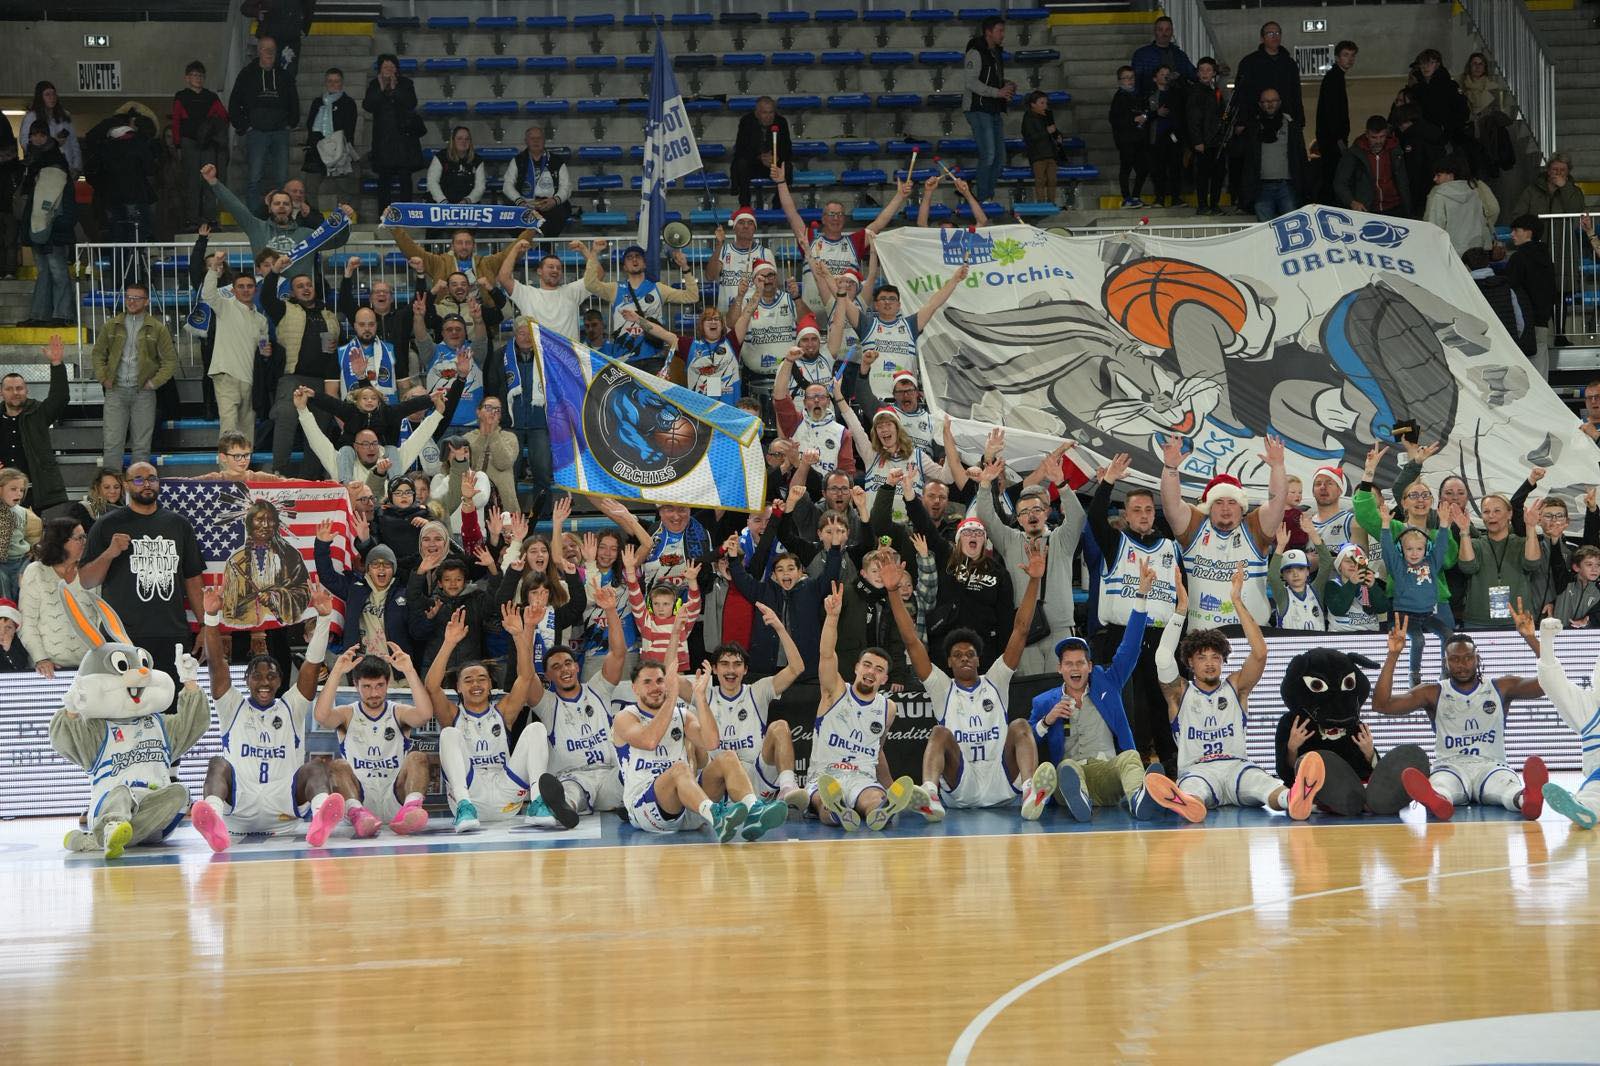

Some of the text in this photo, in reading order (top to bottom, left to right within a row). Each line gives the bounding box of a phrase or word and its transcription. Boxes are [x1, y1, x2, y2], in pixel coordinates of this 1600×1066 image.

[79, 64, 116, 89] BUVETTE
[430, 206, 493, 223] ORCHIES
[1281, 248, 1416, 277] ORCHIES
[965, 265, 1074, 288] d'Orchies
[1184, 431, 1235, 476] BUGS
[612, 461, 677, 485] ORCHIES
[1122, 574, 1141, 585] Nou
[719, 735, 754, 751] RCHIES
[954, 727, 1000, 743] ORCHIES
[1188, 724, 1234, 741] ORCHIES
[259, 762, 268, 784] 8
